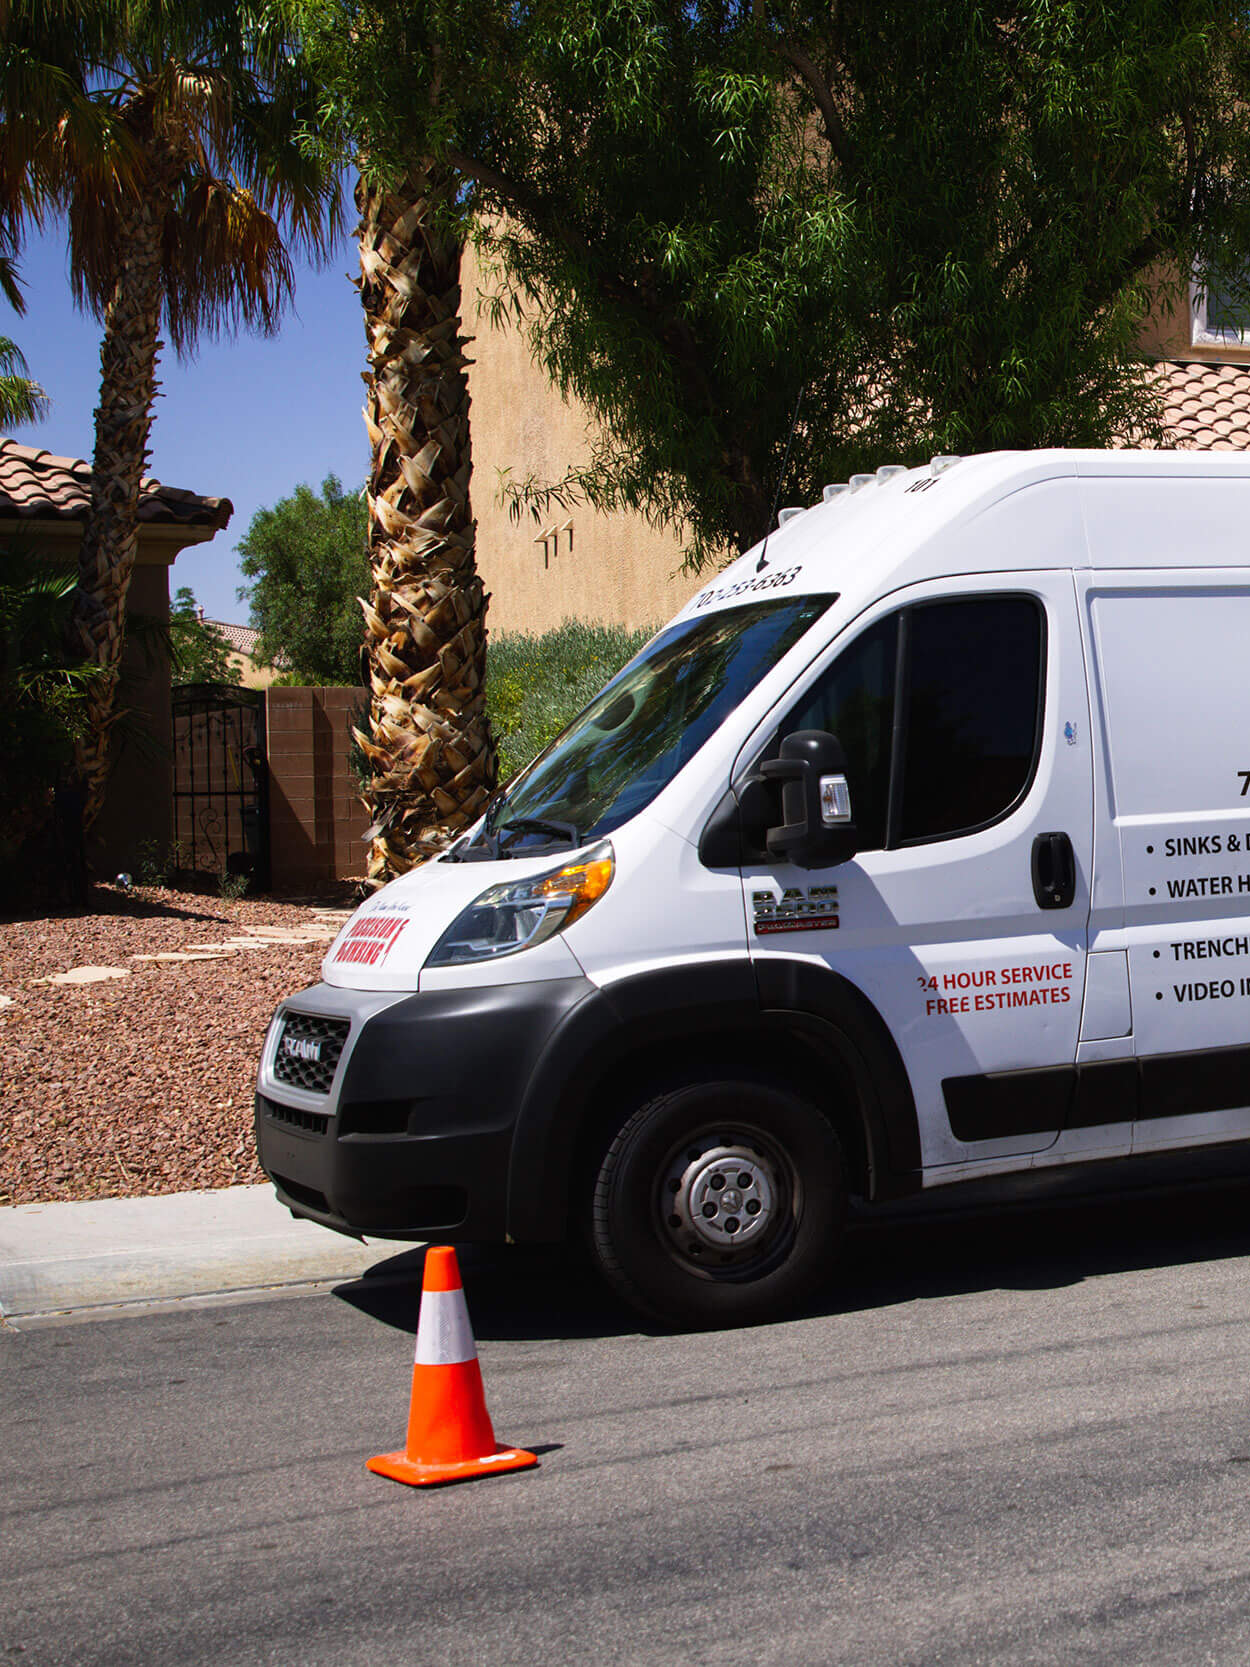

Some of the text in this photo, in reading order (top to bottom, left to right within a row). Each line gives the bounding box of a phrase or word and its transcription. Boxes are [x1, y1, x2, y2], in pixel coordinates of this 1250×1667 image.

[904, 478, 940, 493] 101
[1164, 836, 1222, 858] SINKS
[1226, 835, 1241, 853] &
[1167, 876, 1233, 899] WATER
[943, 970, 997, 990] HOUR
[1000, 963, 1073, 985] SERVICE
[926, 986, 1071, 1016] FREE ESTIMATES
[1174, 980, 1235, 1003] VIDEO
